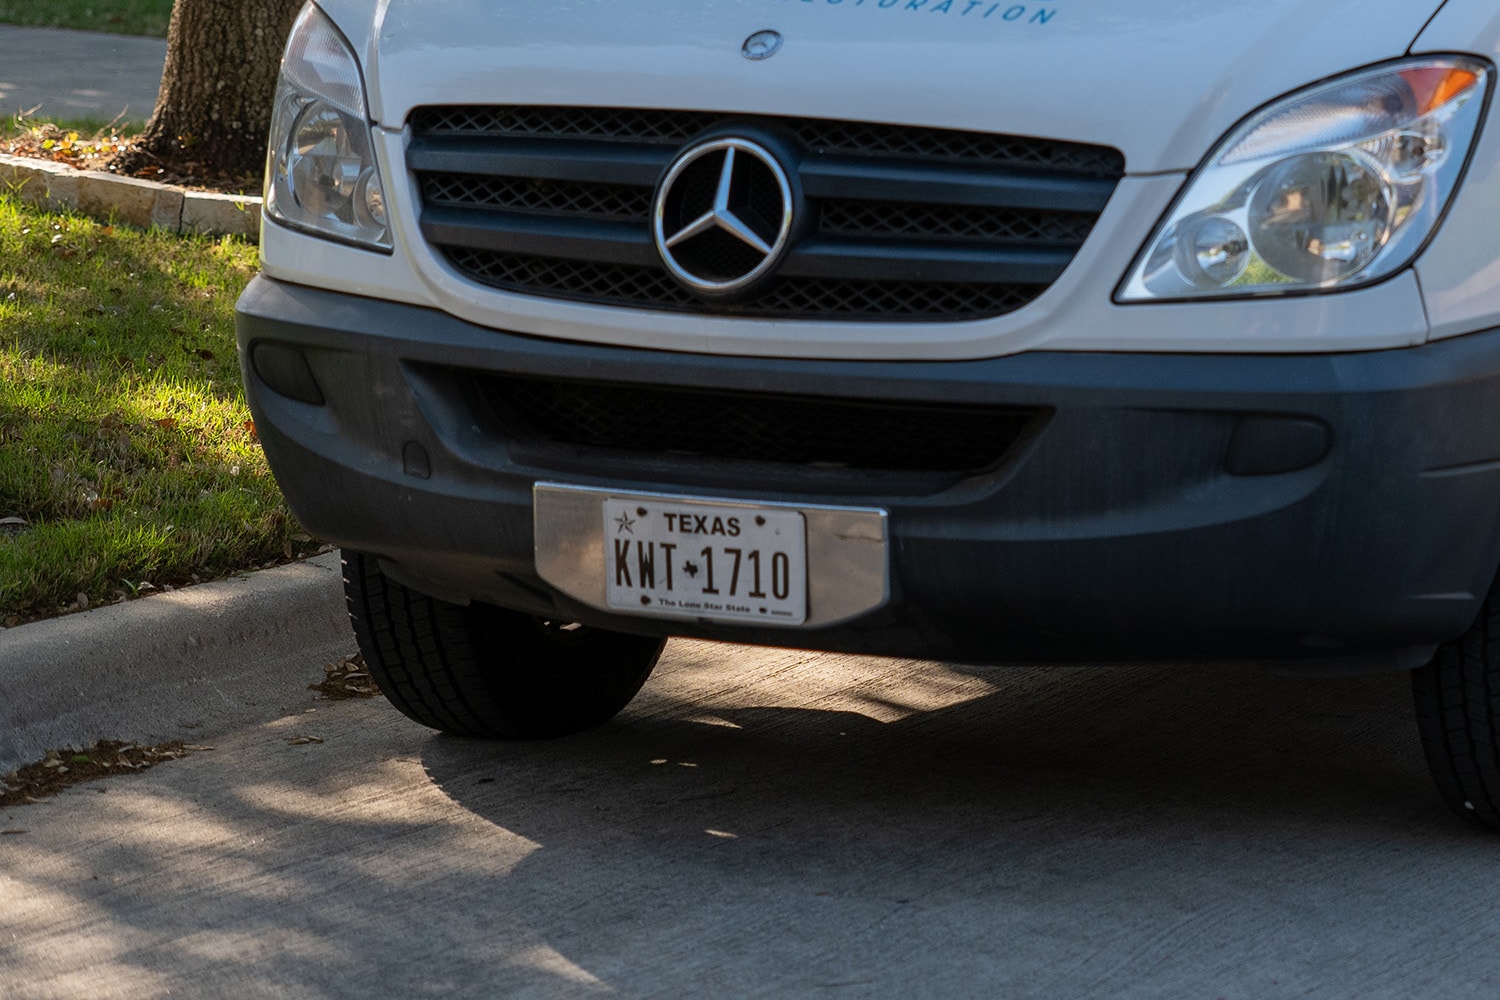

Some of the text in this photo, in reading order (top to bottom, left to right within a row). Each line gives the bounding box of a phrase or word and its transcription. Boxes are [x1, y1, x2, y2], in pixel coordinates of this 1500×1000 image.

[663, 513, 742, 537] TEXAS
[700, 547, 790, 600] 1710
[658, 597, 751, 613] The Lone Star State
